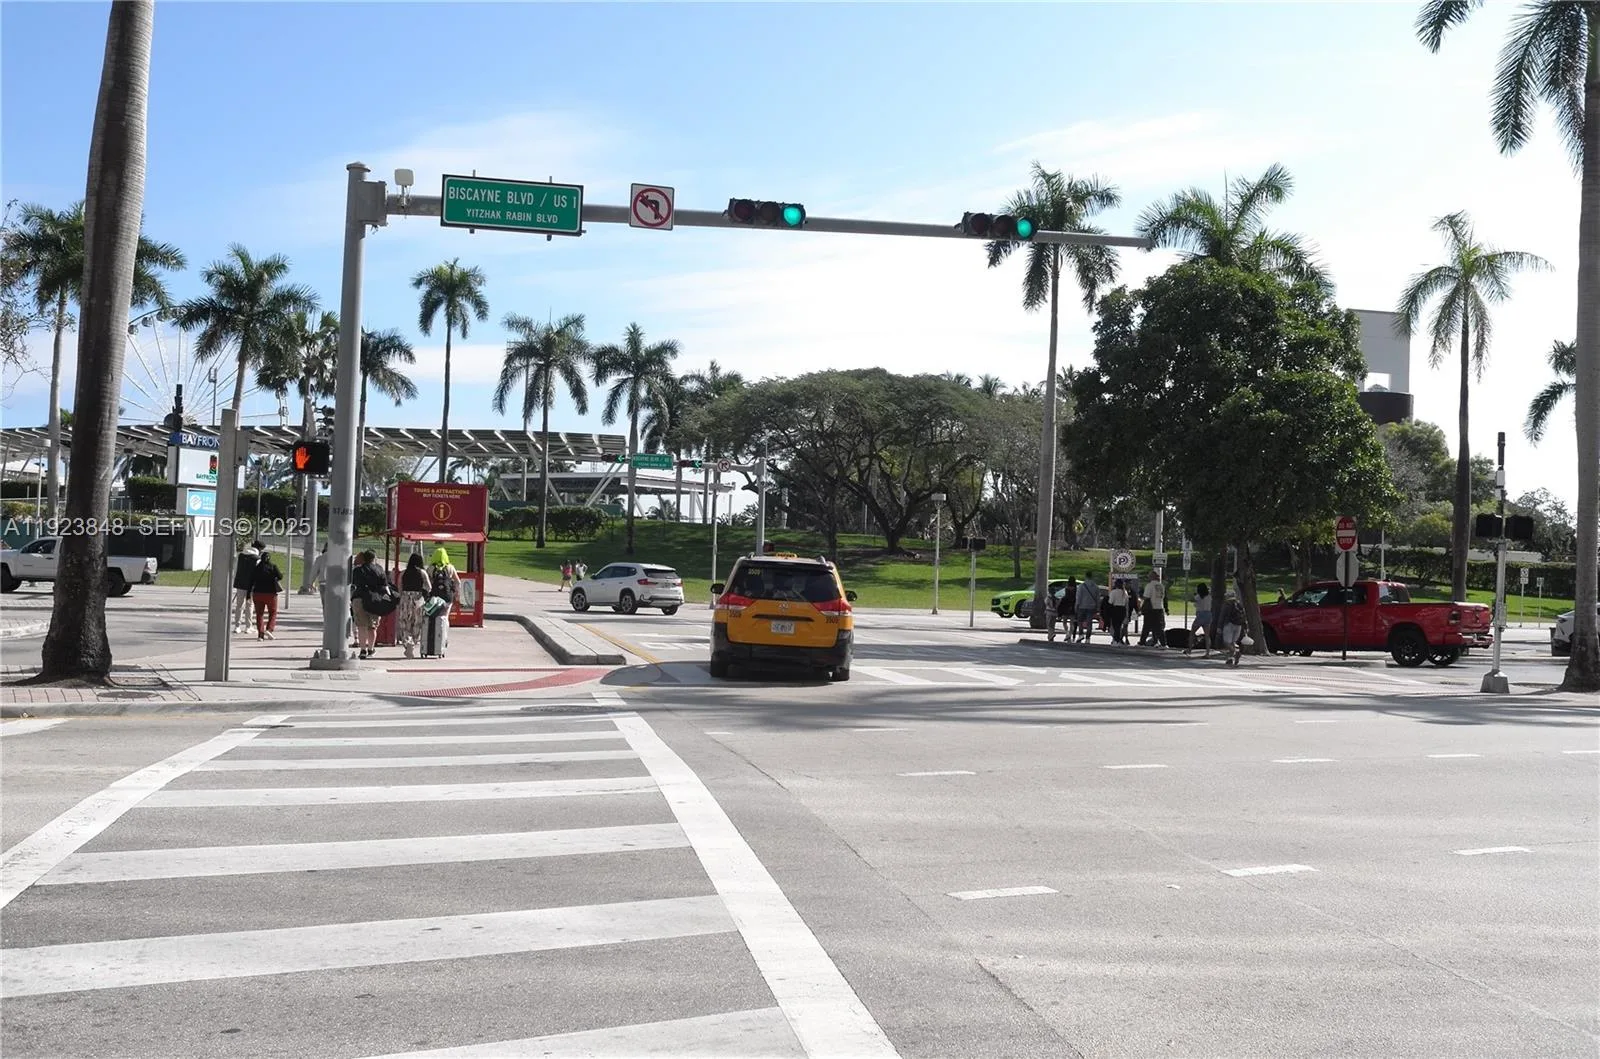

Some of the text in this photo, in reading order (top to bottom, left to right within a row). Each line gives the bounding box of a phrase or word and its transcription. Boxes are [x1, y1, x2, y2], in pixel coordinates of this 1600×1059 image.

[448, 187, 501, 203] BISCAYNE
[507, 191, 534, 206] BLVD
[539, 192, 548, 207] /
[553, 195, 568, 208] US
[466, 208, 559, 224] YITZHAK RABIN BLVD
